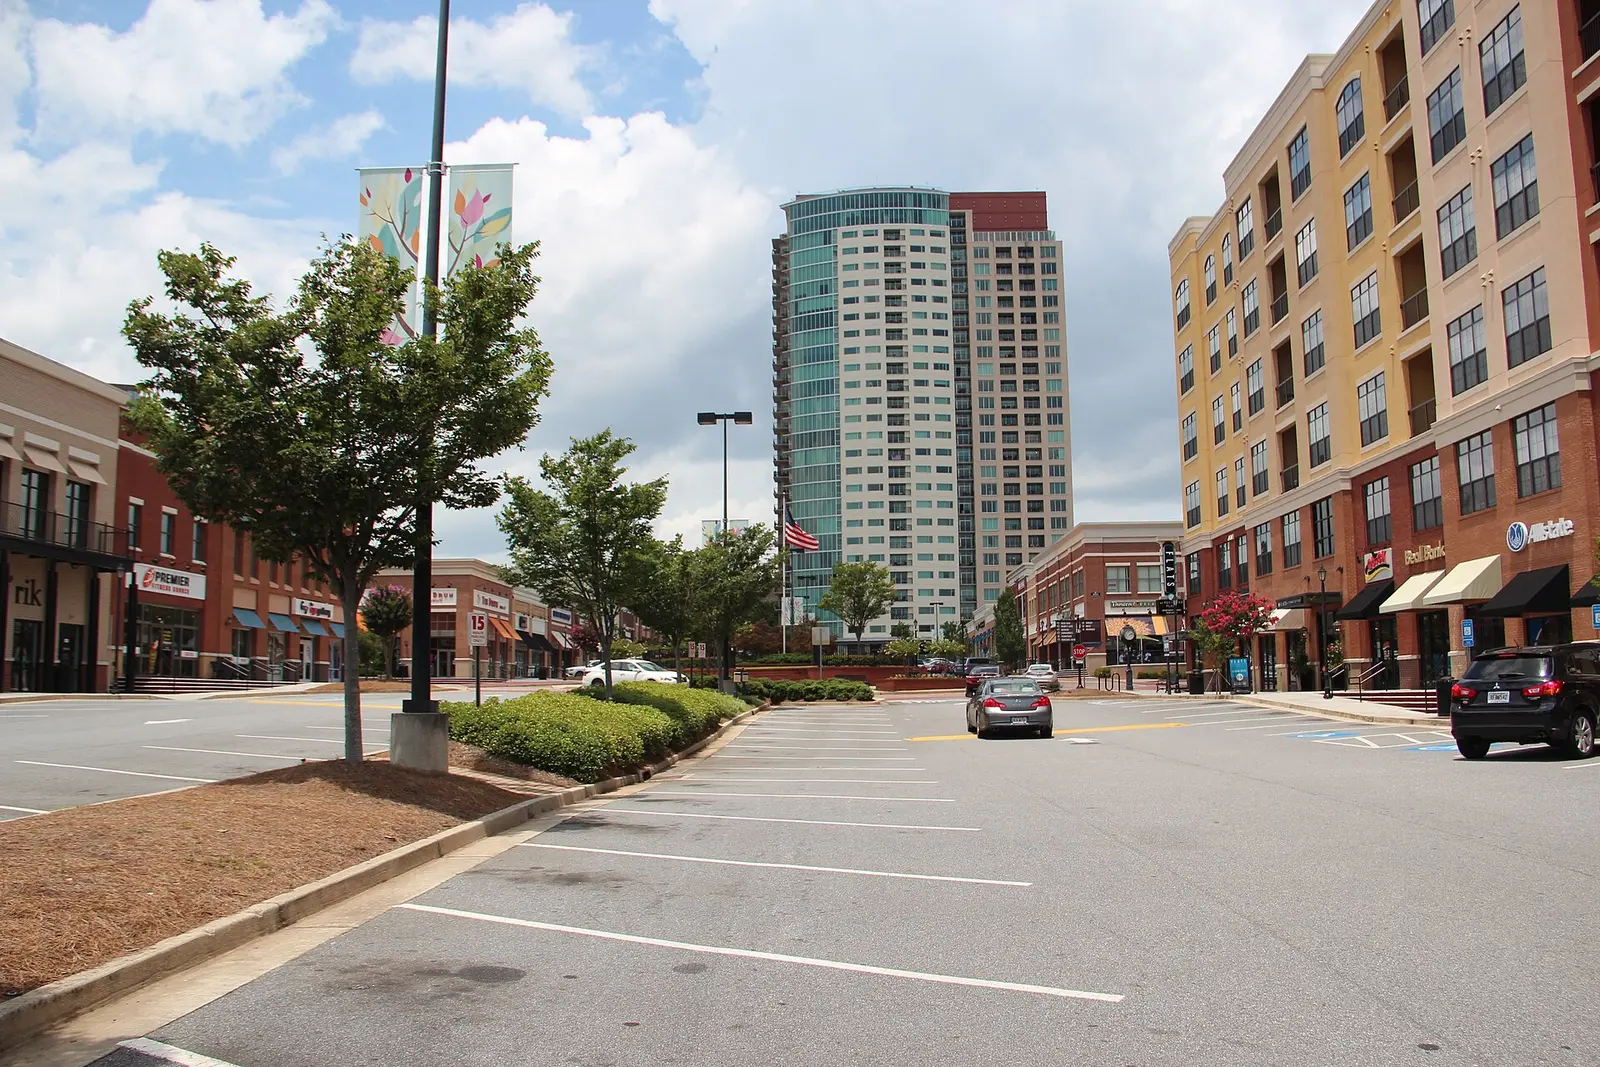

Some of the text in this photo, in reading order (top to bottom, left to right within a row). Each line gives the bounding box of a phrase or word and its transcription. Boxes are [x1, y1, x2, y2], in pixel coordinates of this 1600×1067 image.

[1527, 517, 1575, 544] Allstate
[1424, 540, 1446, 560] Bank
[155, 571, 190, 586] PREMIER
[1165, 551, 1175, 587] FLATS
[471, 615, 485, 630] 15
